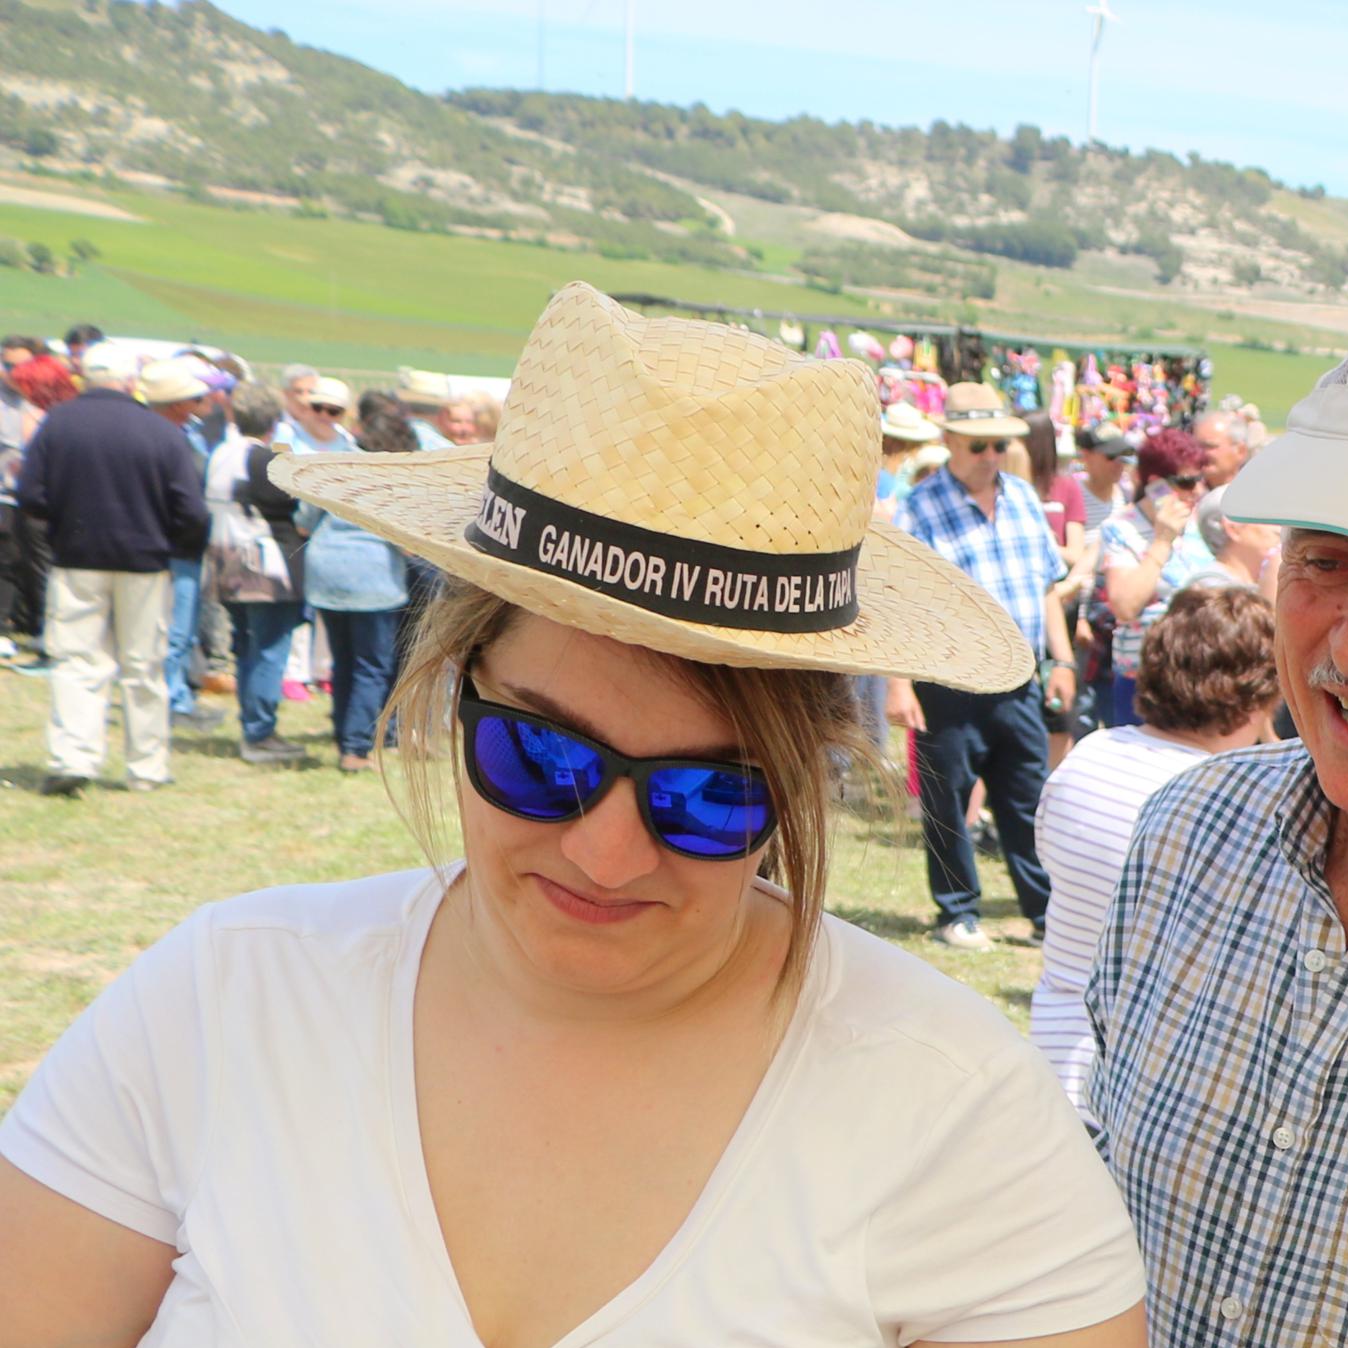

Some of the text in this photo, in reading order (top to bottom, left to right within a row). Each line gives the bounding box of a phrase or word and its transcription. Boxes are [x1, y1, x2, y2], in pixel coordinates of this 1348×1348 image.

[538, 524, 666, 596] GANADOR
[670, 561, 702, 602] IV
[704, 567, 769, 610] RUTA
[774, 575, 802, 613] DE
[804, 575, 825, 612] LA
[828, 567, 852, 610] TAPA
